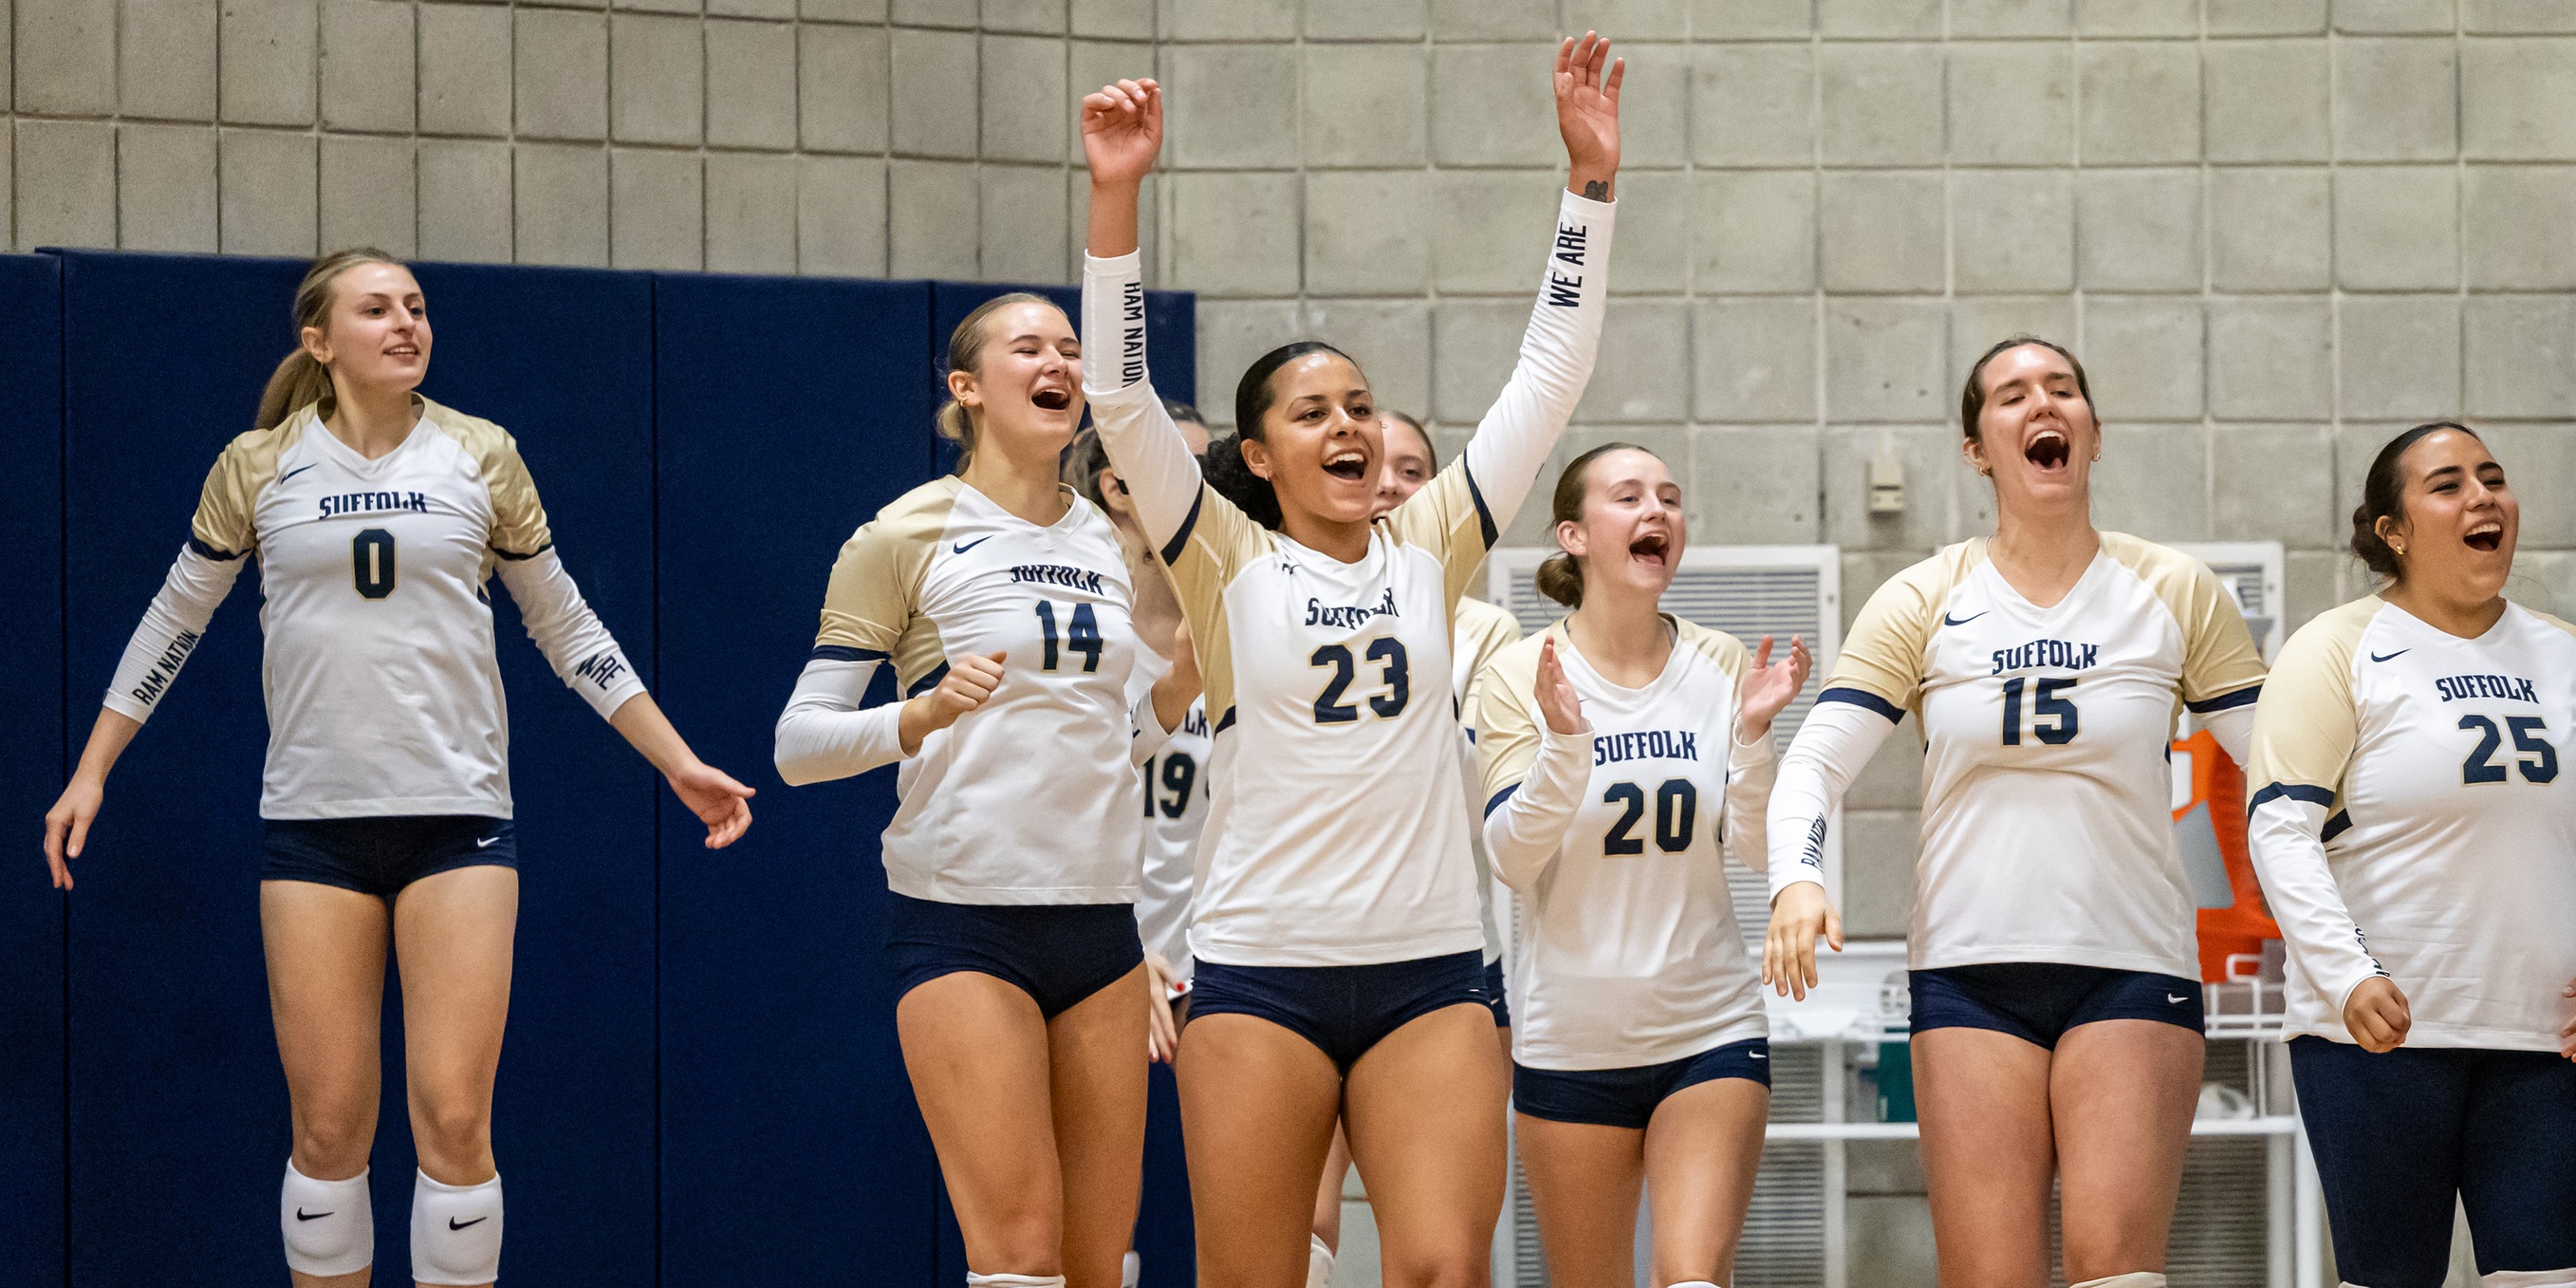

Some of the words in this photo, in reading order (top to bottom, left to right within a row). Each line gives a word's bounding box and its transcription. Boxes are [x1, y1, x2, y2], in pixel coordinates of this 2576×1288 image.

[1556, 222, 1586, 266] ARE
[1548, 271, 1583, 308] WE
[319, 492, 428, 520] SUFFOLK
[350, 526, 398, 602] 0
[1010, 565, 1104, 596] SUFFOLK
[132, 669, 168, 705] RAM
[158, 629, 198, 675] NATION
[1033, 600, 1103, 675] 14
[1992, 639, 2100, 675] SUFFOLK
[1308, 634, 1412, 725] 23
[2000, 677, 2082, 748] 15
[2436, 675, 2540, 704] SUFFOLK
[1594, 730, 1698, 766] SUFFOLK
[2456, 714, 2560, 788] 25
[1143, 750, 1196, 819] 19
[1602, 775, 1698, 858] 20
